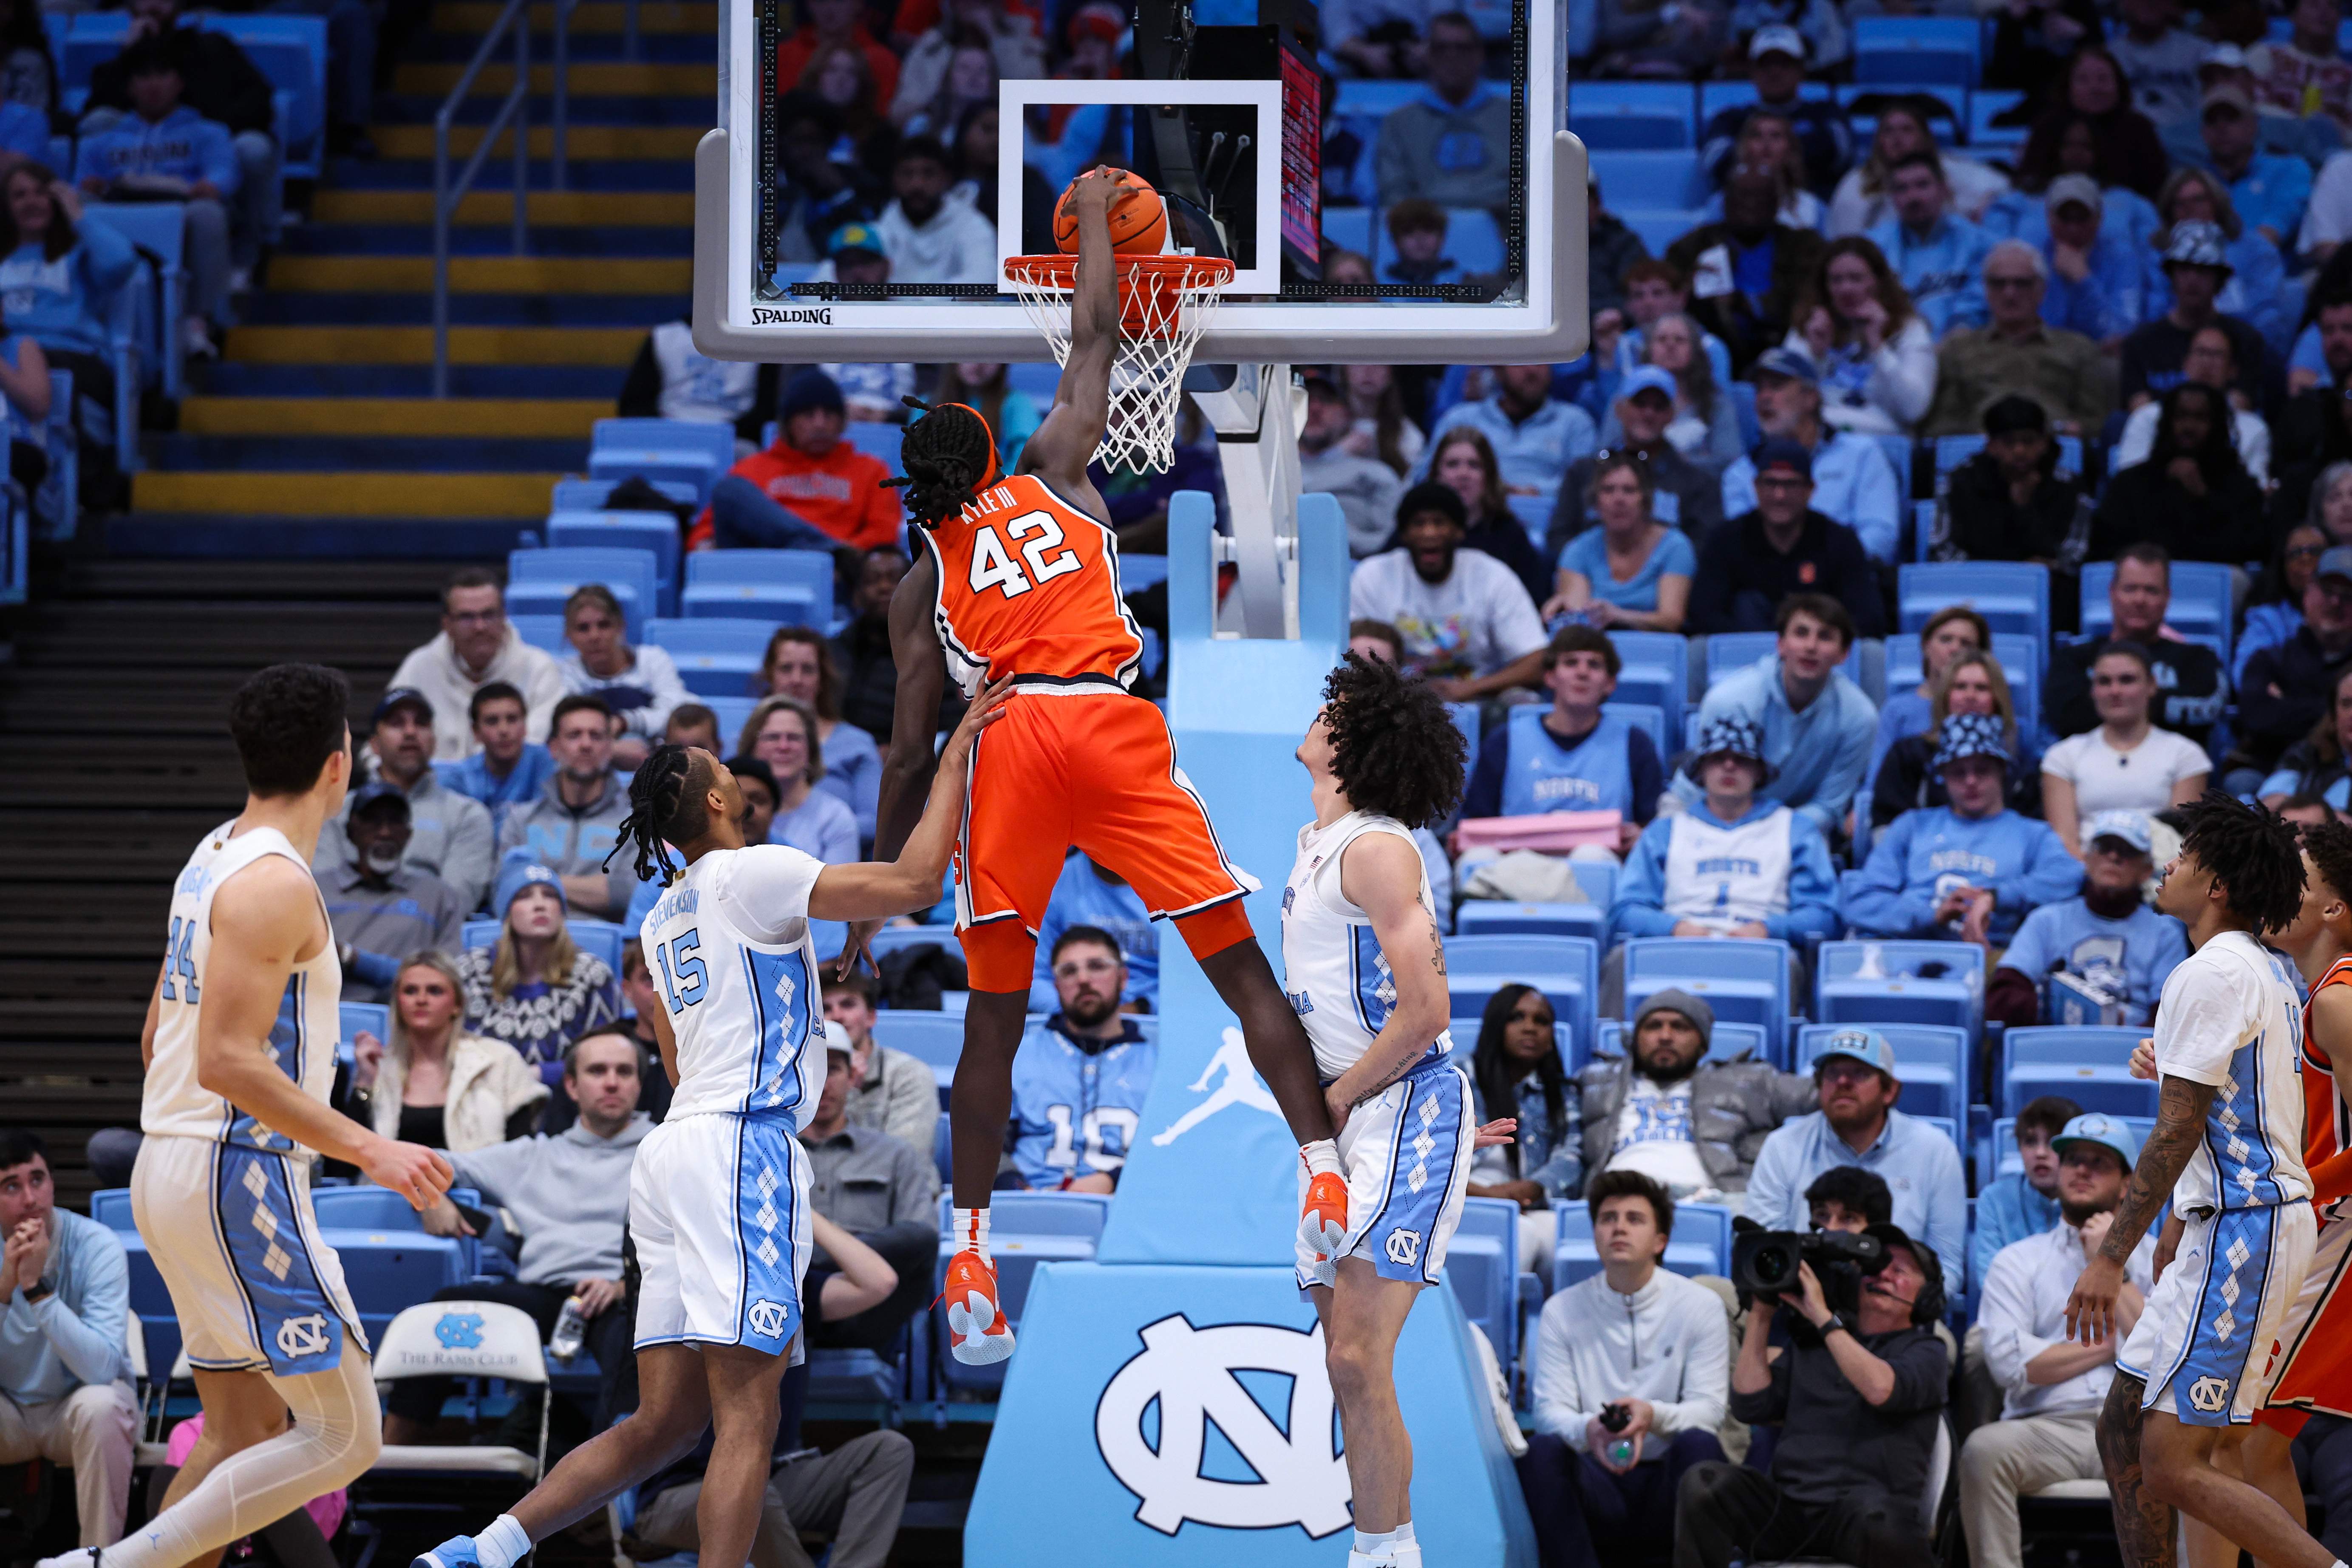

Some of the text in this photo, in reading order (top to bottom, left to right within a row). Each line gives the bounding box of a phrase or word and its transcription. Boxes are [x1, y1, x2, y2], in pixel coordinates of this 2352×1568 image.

[752, 308, 831, 325] SPALDING
[968, 509, 1084, 600] 42
[650, 889, 700, 936] STEVENSON
[657, 927, 709, 1016] 15
[401, 1351, 518, 1365] THE RAMS CLUB
